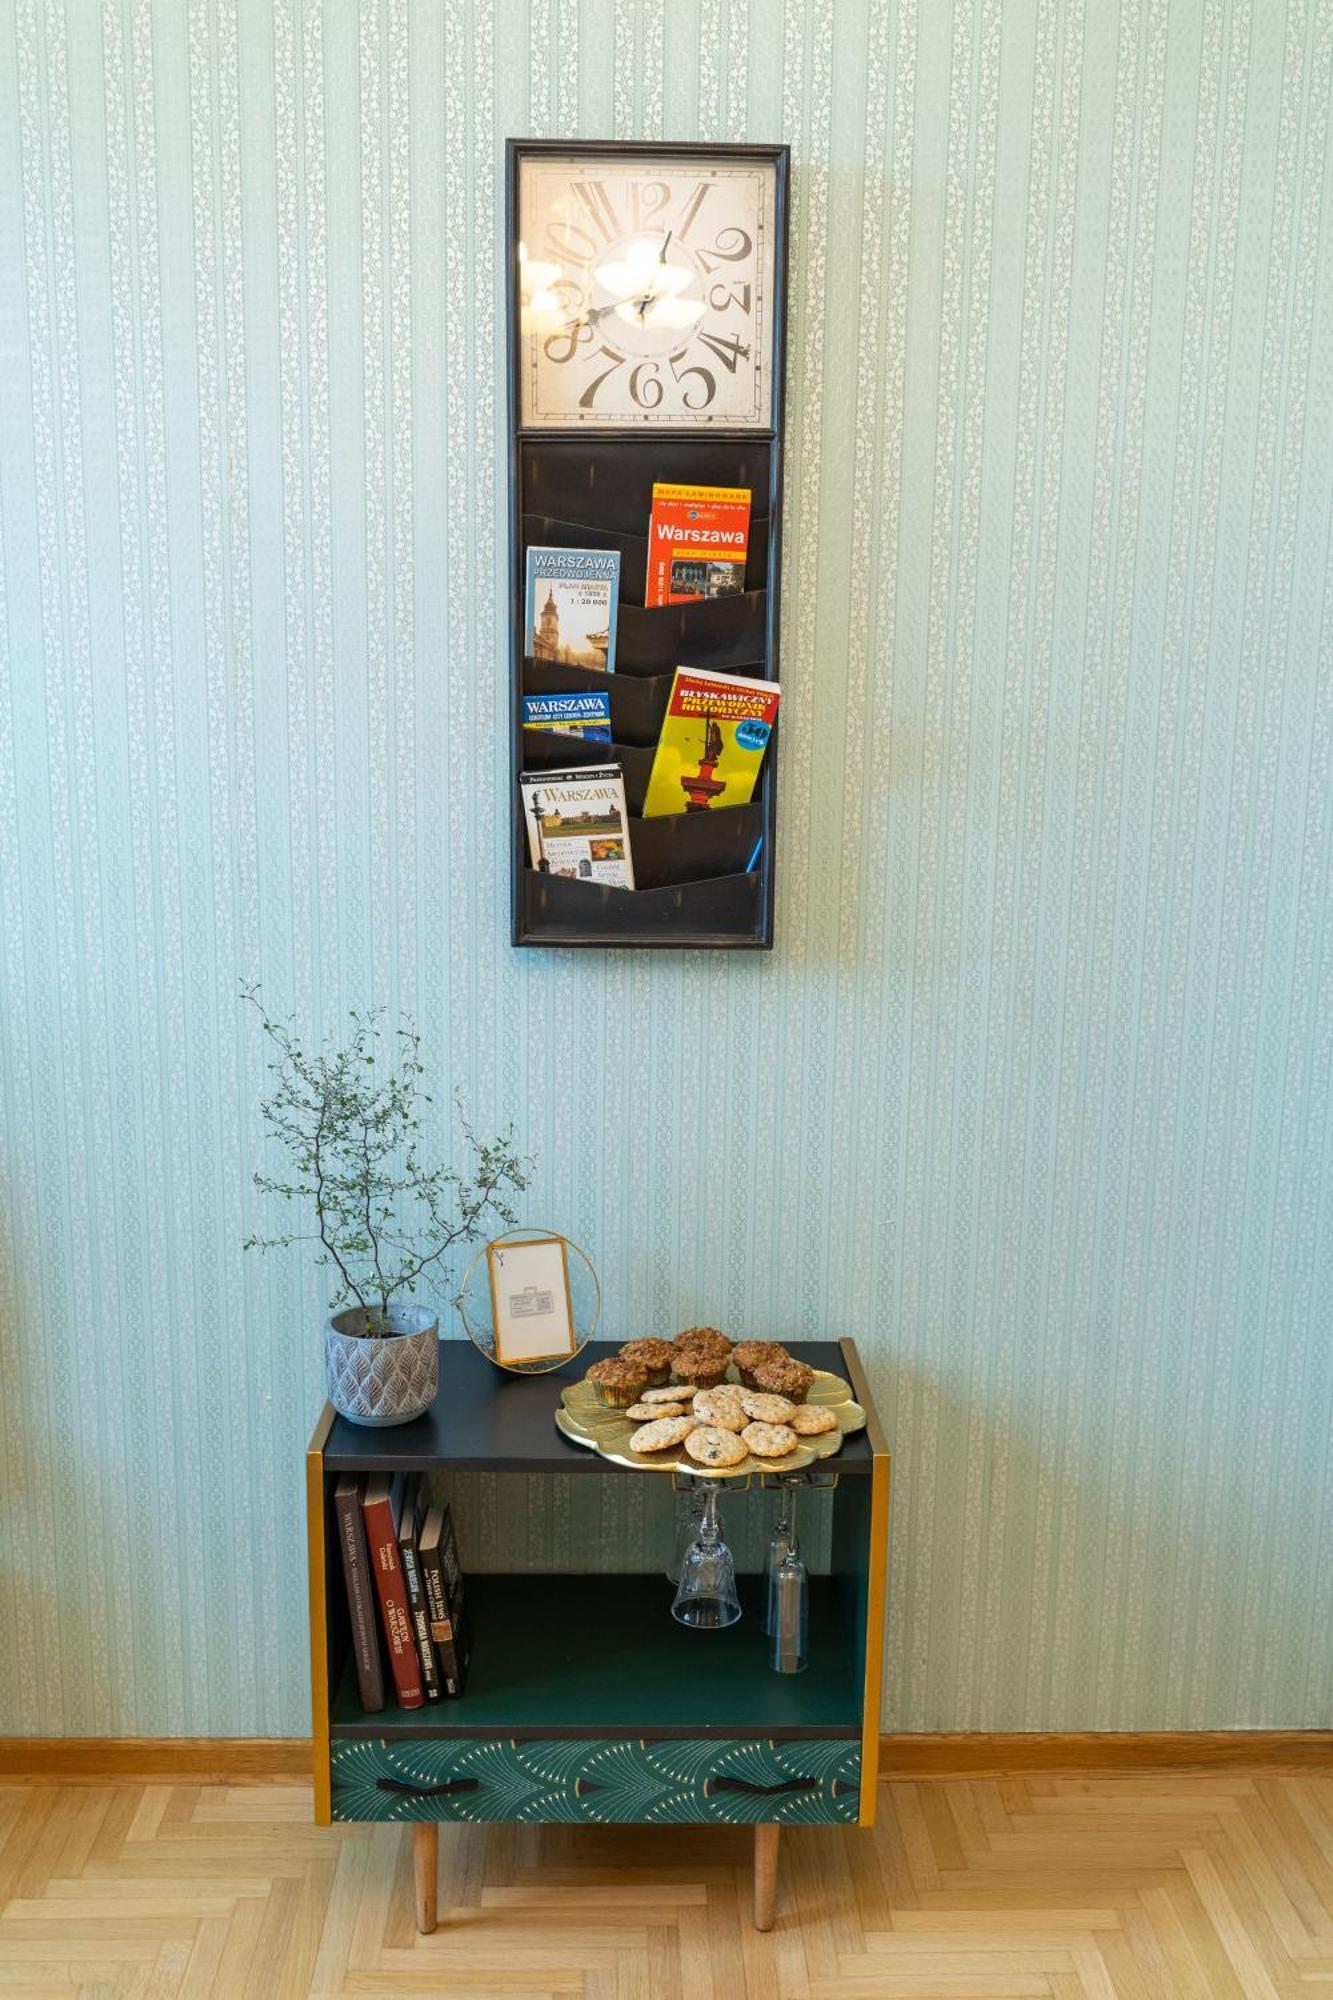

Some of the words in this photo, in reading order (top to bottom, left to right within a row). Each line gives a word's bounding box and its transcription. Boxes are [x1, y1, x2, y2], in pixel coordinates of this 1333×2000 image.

[626, 181, 671, 232] 12
[678, 183, 717, 241] 1
[544, 222, 597, 269] 10
[695, 227, 753, 274] 2
[709, 281, 751, 316] 3
[543, 321, 594, 363] 8
[697, 331, 752, 374] 4
[579, 345, 627, 409] 7
[629, 362, 663, 408] 6
[669, 349, 717, 410] 5
[657, 524, 745, 544] Warszawa
[535, 555, 616, 570] WARSZAWA
[526, 698, 605, 713] WARSZAWA
[543, 788, 619, 802] WARSZAWA
[344, 1512, 357, 1562] WARSZAWA
